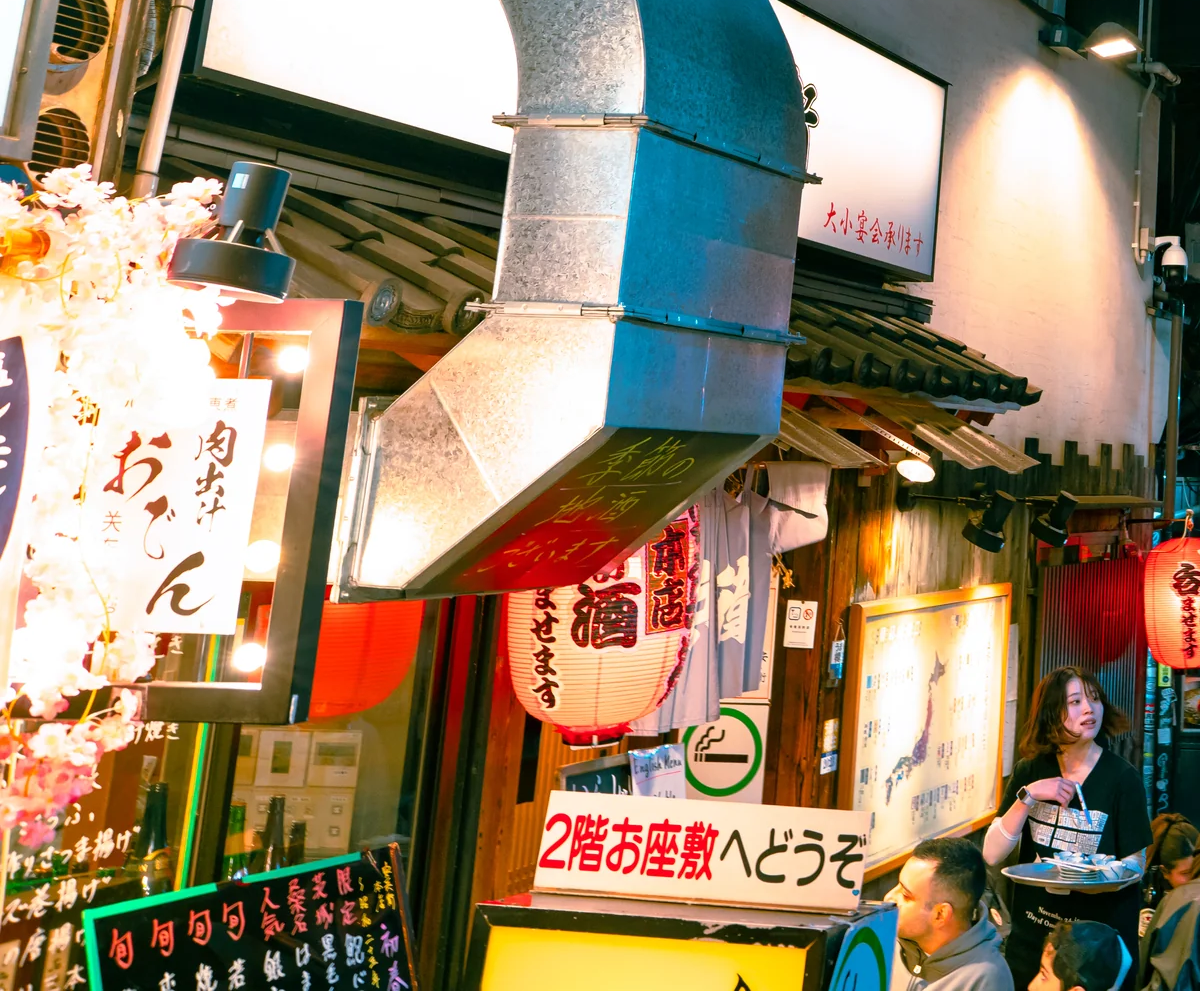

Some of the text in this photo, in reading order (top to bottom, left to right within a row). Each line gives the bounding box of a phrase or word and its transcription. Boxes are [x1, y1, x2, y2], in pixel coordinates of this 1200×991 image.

[823, 201, 925, 258] 大小宴会承ります
[103, 430, 216, 616] おでん
[538, 812, 867, 890] 2階お座敷へどうぞ
[151, 918, 174, 957] 旬
[187, 909, 213, 946] 旬
[222, 901, 246, 941] 旬
[260, 886, 286, 942] 人気
[108, 928, 134, 970] 旬
